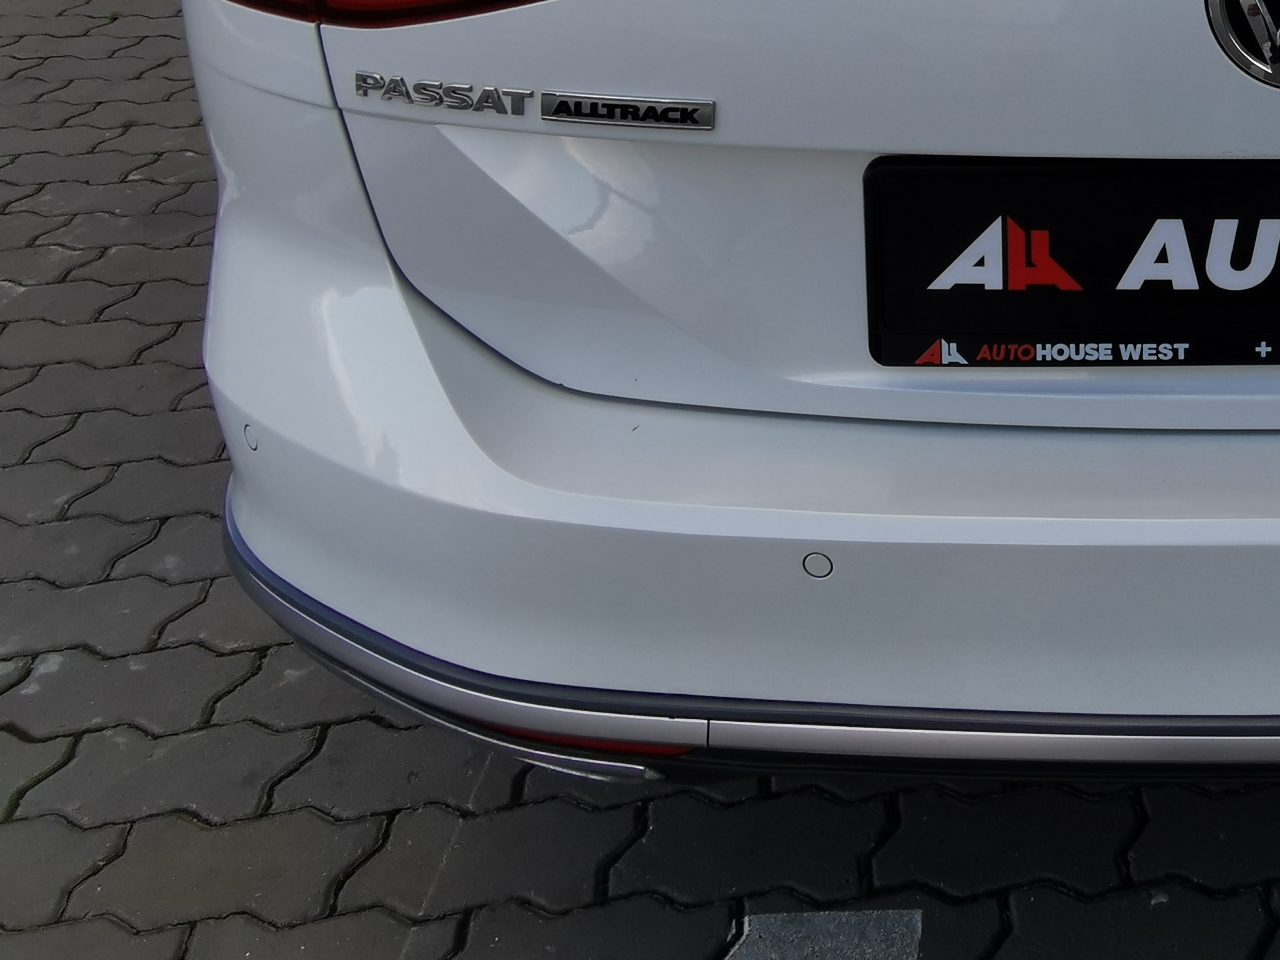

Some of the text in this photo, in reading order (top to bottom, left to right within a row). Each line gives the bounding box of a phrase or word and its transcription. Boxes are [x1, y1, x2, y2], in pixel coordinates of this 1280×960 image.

[355, 70, 701, 125] PASSAT ALLTRACK
[1119, 343, 1190, 361] WEST
